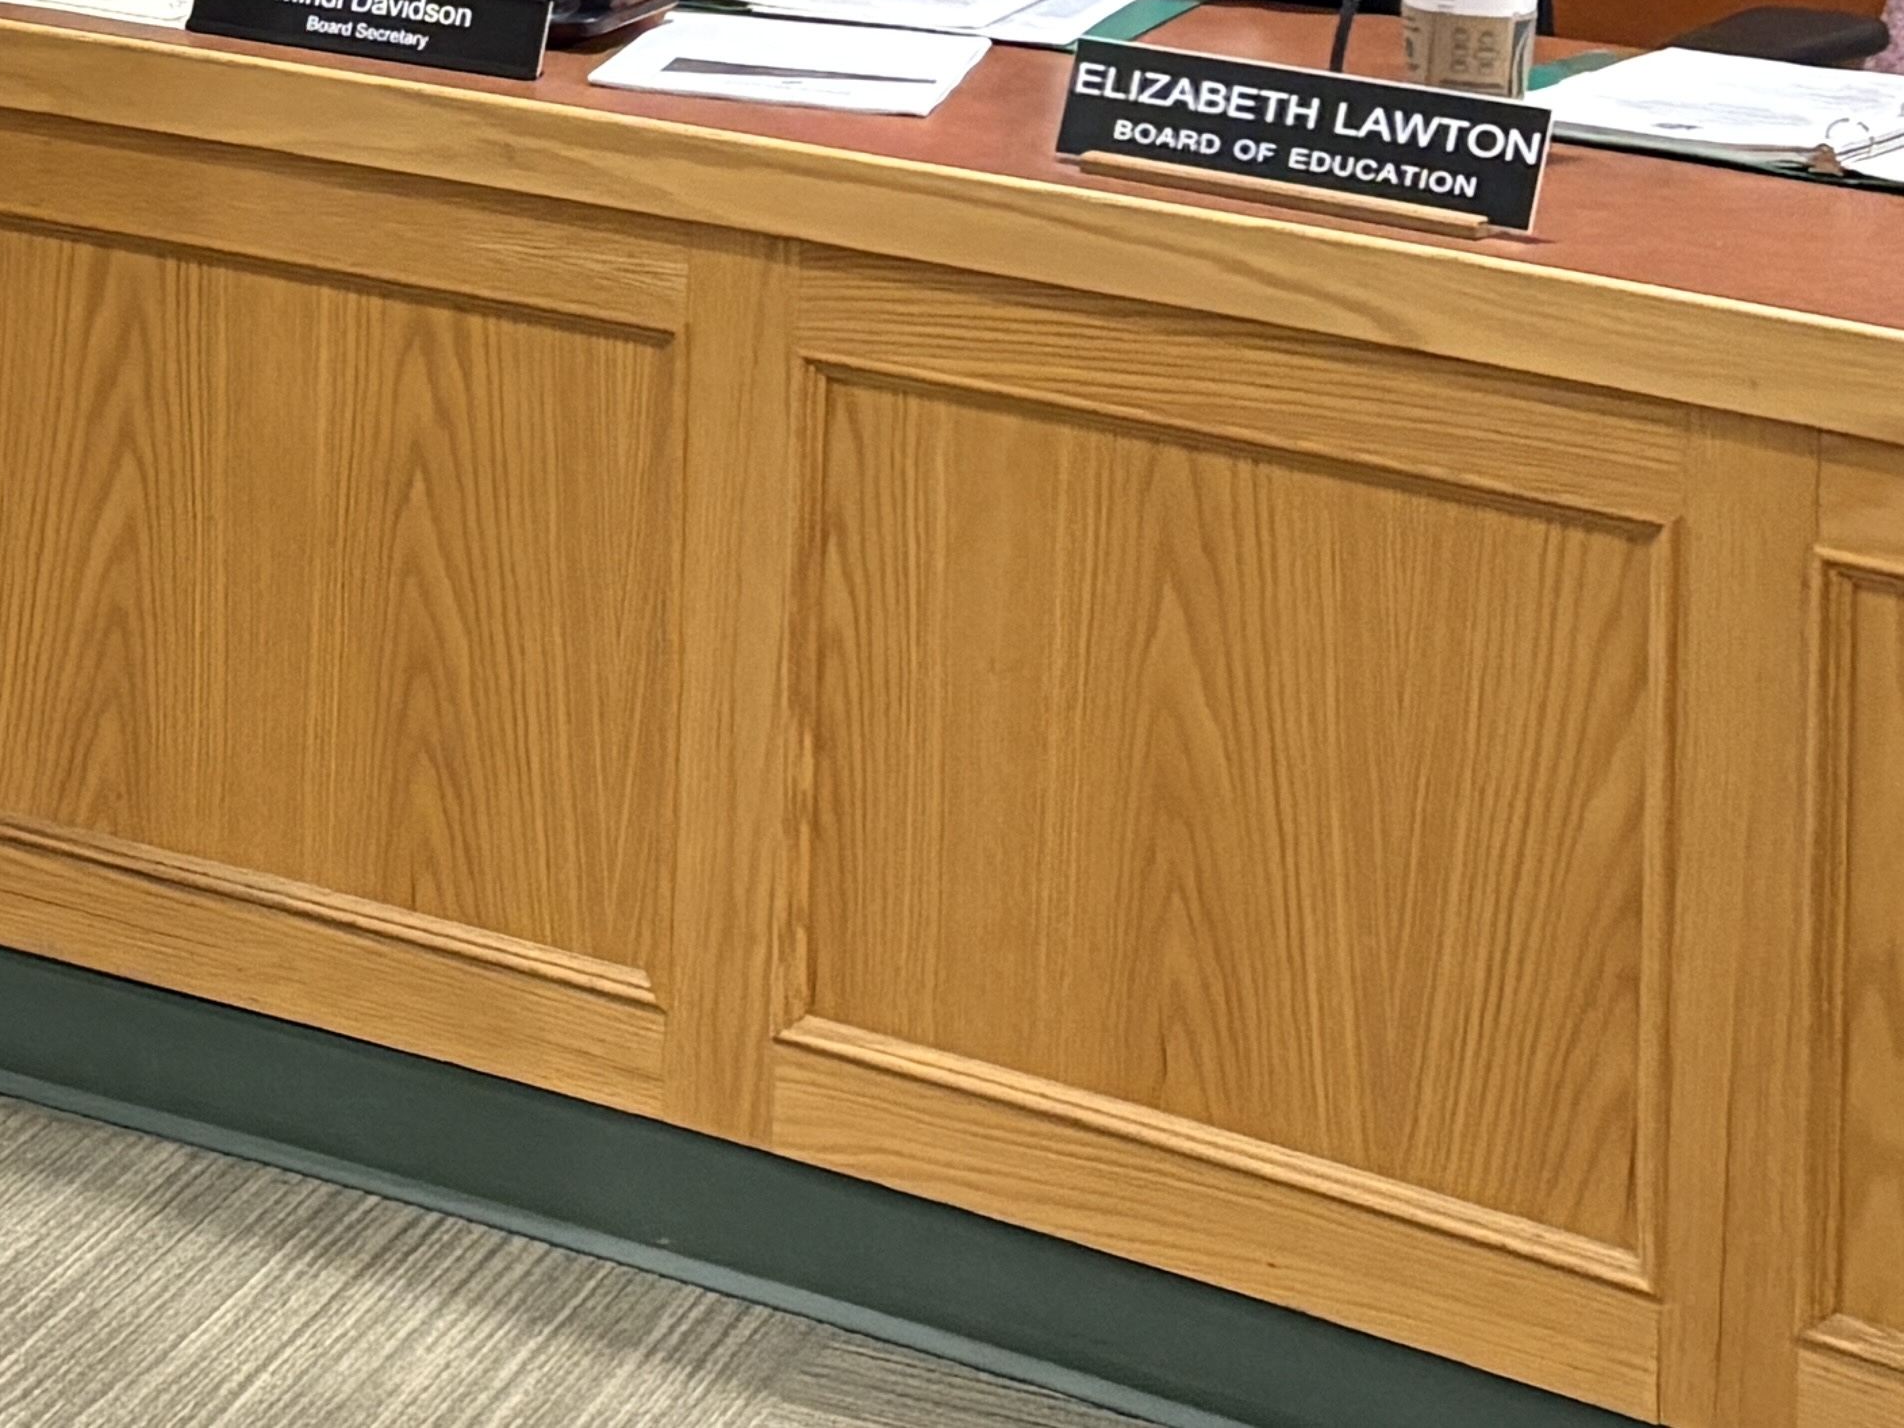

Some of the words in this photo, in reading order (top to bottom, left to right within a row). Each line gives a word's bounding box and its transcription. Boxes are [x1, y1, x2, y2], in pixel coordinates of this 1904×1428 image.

[305, 14, 353, 37] Board
[354, 22, 430, 51] Secretary
[1074, 61, 1321, 131] ELIZABETH
[1333, 101, 1542, 167] LAWTON
[1112, 118, 1222, 156] BOARD
[1233, 137, 1278, 164] OF
[1287, 146, 1478, 198] EDUCATION
